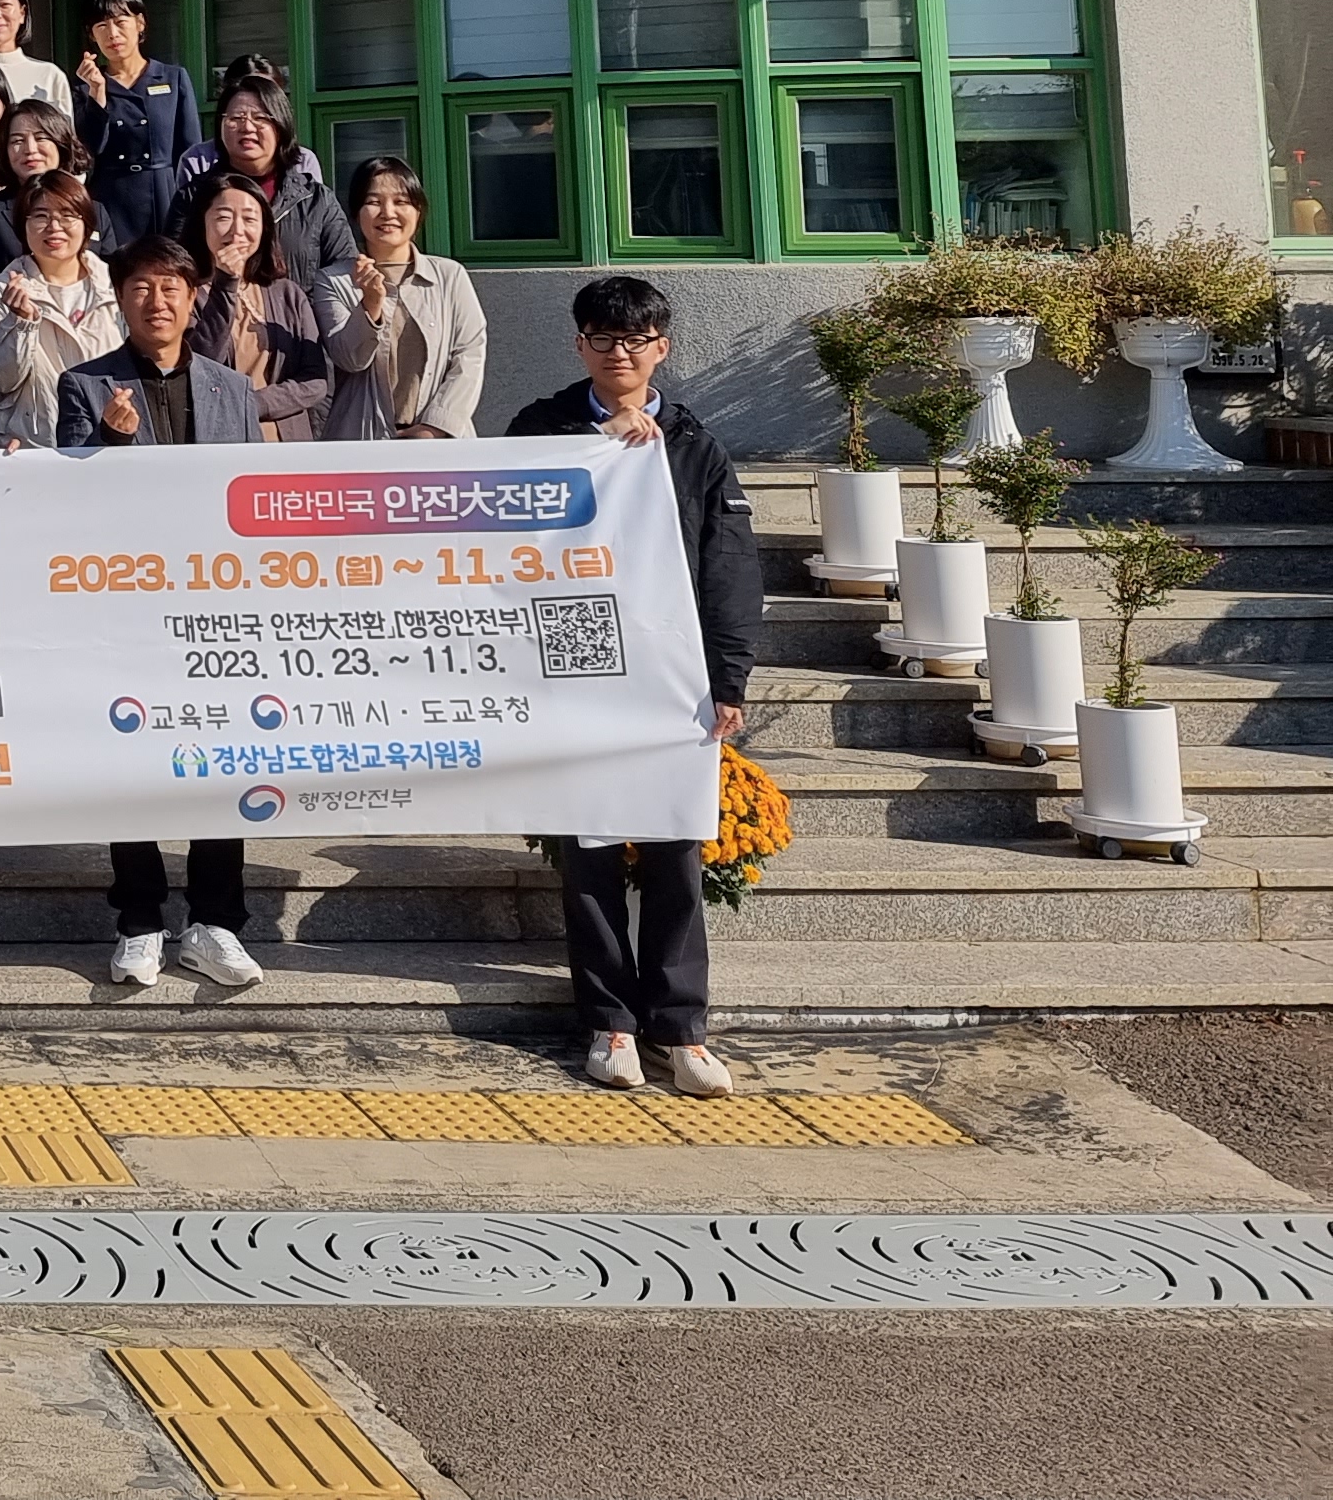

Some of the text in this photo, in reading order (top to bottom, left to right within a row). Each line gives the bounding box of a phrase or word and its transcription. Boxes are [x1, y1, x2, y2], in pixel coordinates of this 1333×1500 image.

[253, 480, 573, 525] 대한민국 안전大전환
[48, 552, 176, 593] 2023.
[186, 552, 252, 591] 10.
[436, 547, 505, 586] 11.
[184, 648, 269, 680] 2023.
[278, 647, 325, 679] 10.
[330, 646, 380, 678] 23.
[421, 644, 469, 676] 11.
[476, 642, 507, 674] 3.
[151, 702, 231, 731] 교육부
[213, 738, 483, 776] 경상남도합천교육지원청
[297, 787, 413, 812] 행정안전부
